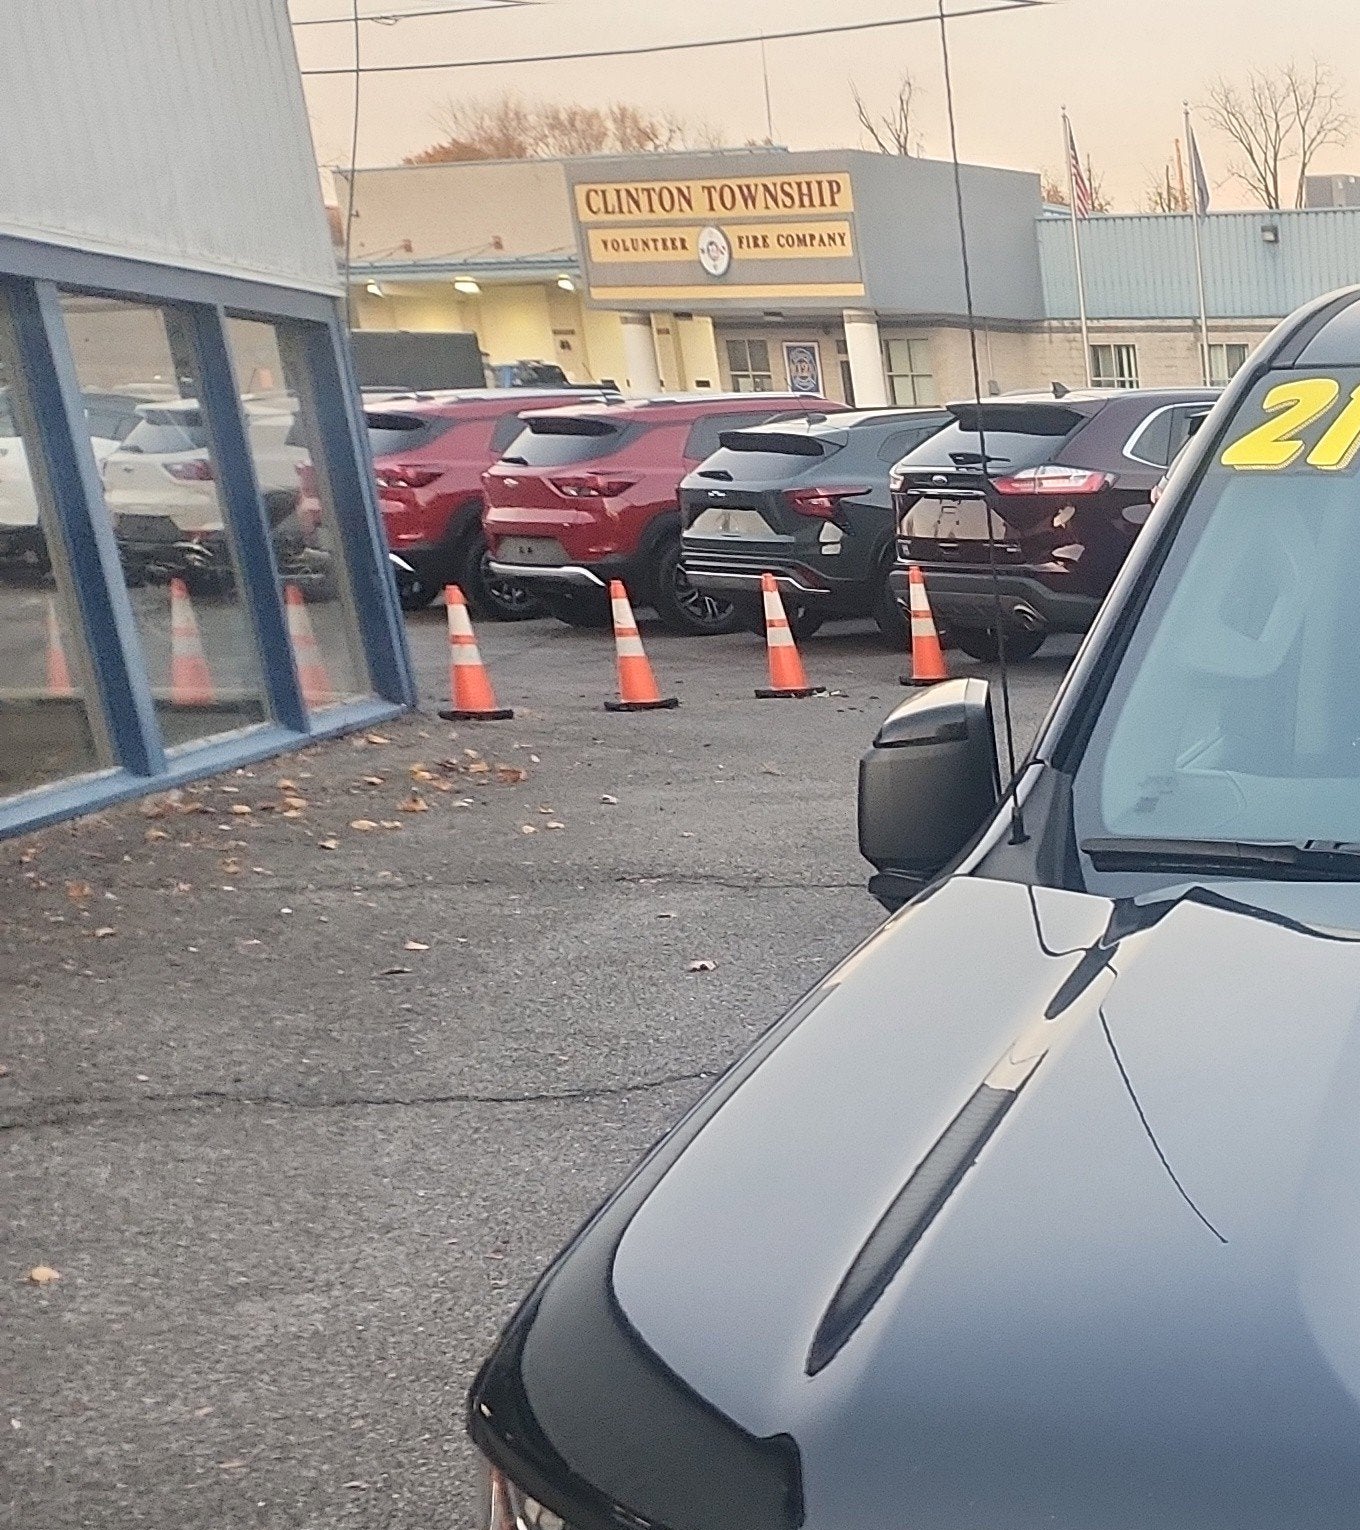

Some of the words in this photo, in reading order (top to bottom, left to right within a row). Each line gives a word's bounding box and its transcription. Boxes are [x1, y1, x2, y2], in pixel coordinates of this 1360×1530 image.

[585, 185, 694, 215] CLINTON
[701, 179, 842, 212] TOWNSHIP
[601, 236, 690, 253] VOLUNTEER
[736, 234, 770, 250] FIRE
[776, 232, 846, 249] COMPANY
